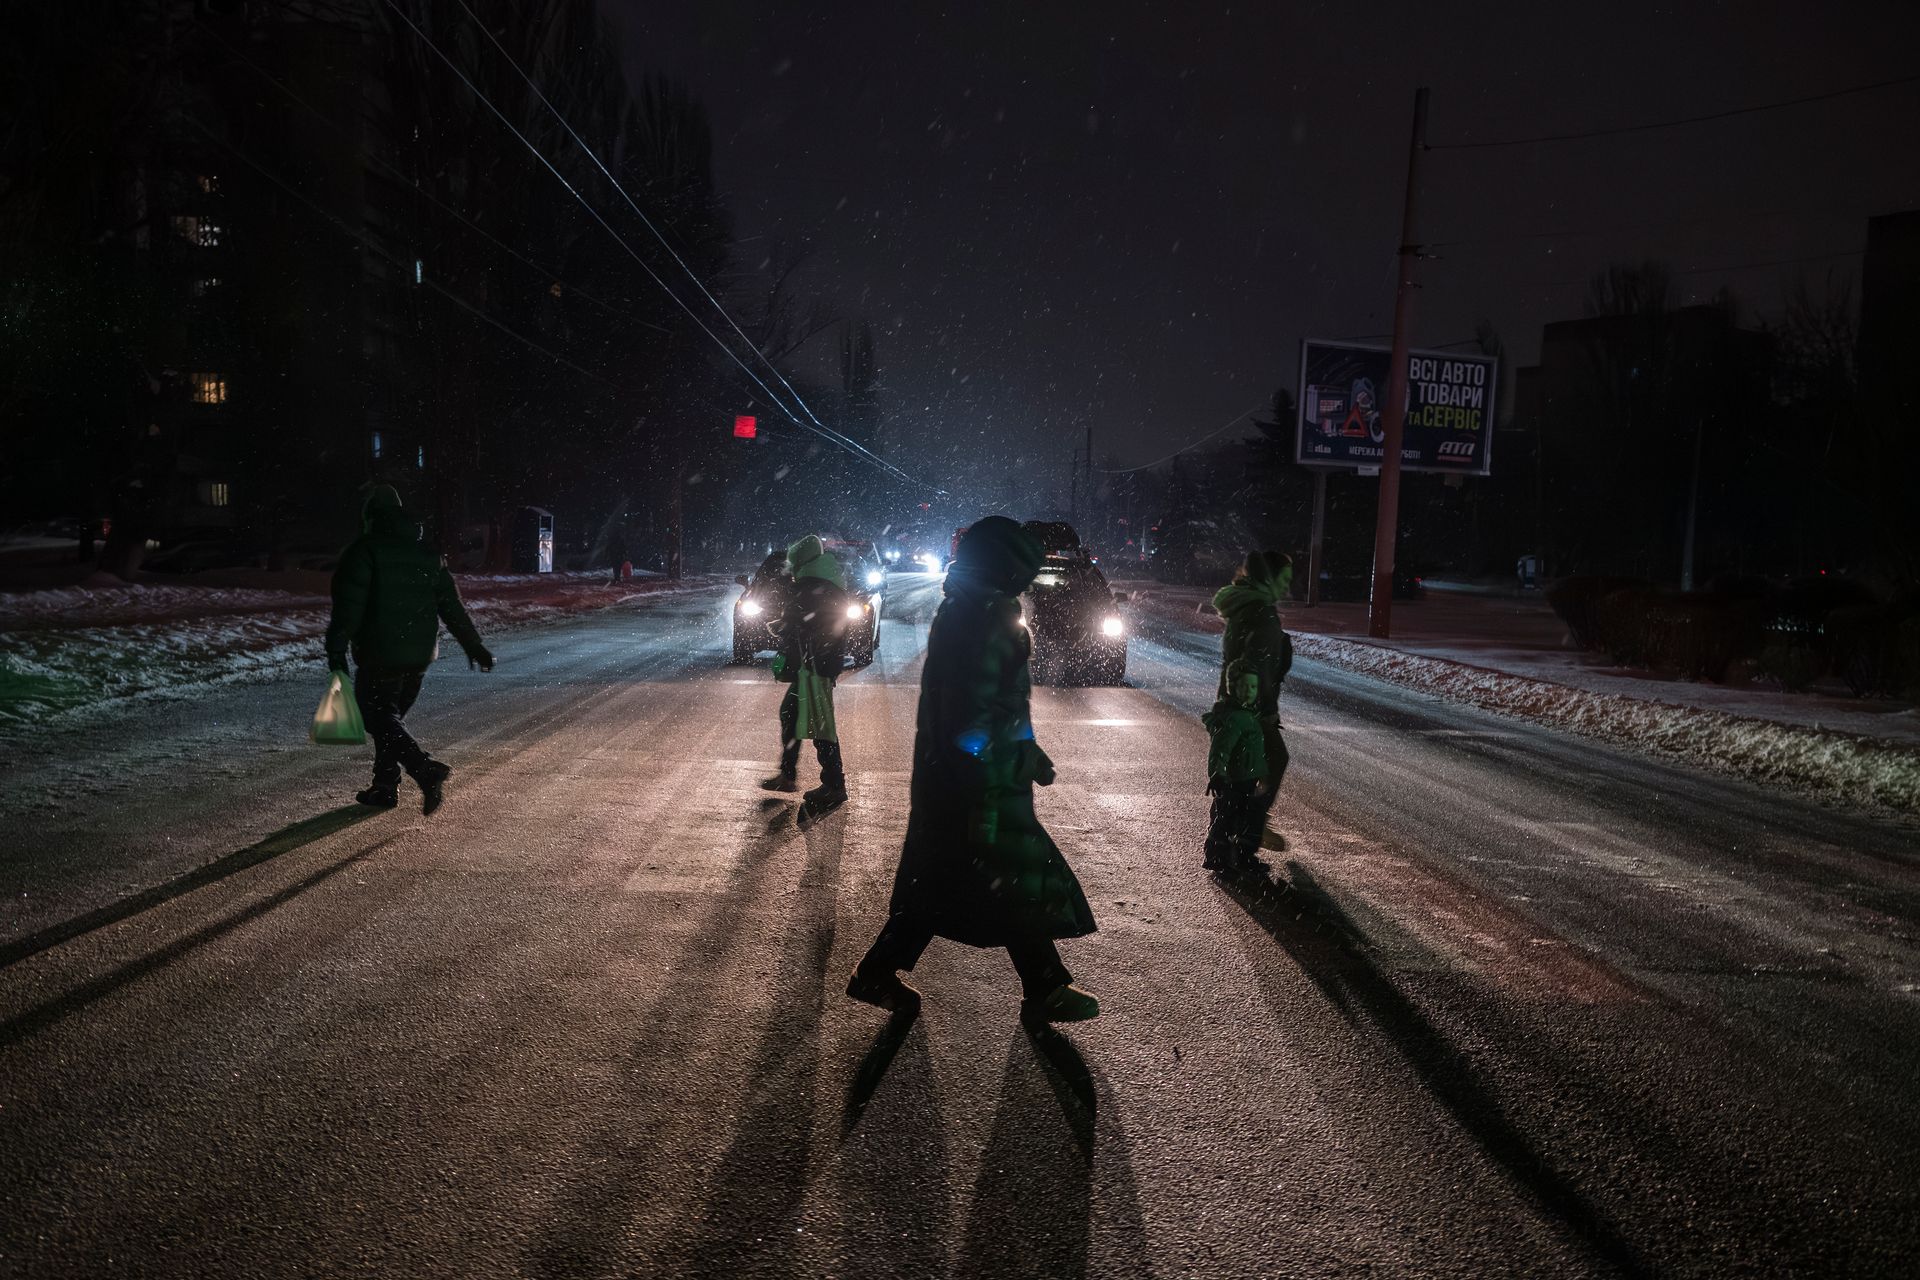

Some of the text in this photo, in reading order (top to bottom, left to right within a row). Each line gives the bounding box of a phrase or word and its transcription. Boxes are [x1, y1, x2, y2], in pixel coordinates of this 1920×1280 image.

[1409, 357, 1485, 386] ВСІ АВТО
[1417, 382, 1483, 409] ТОВАРИ
[1423, 404, 1481, 430] СЕРВІС
